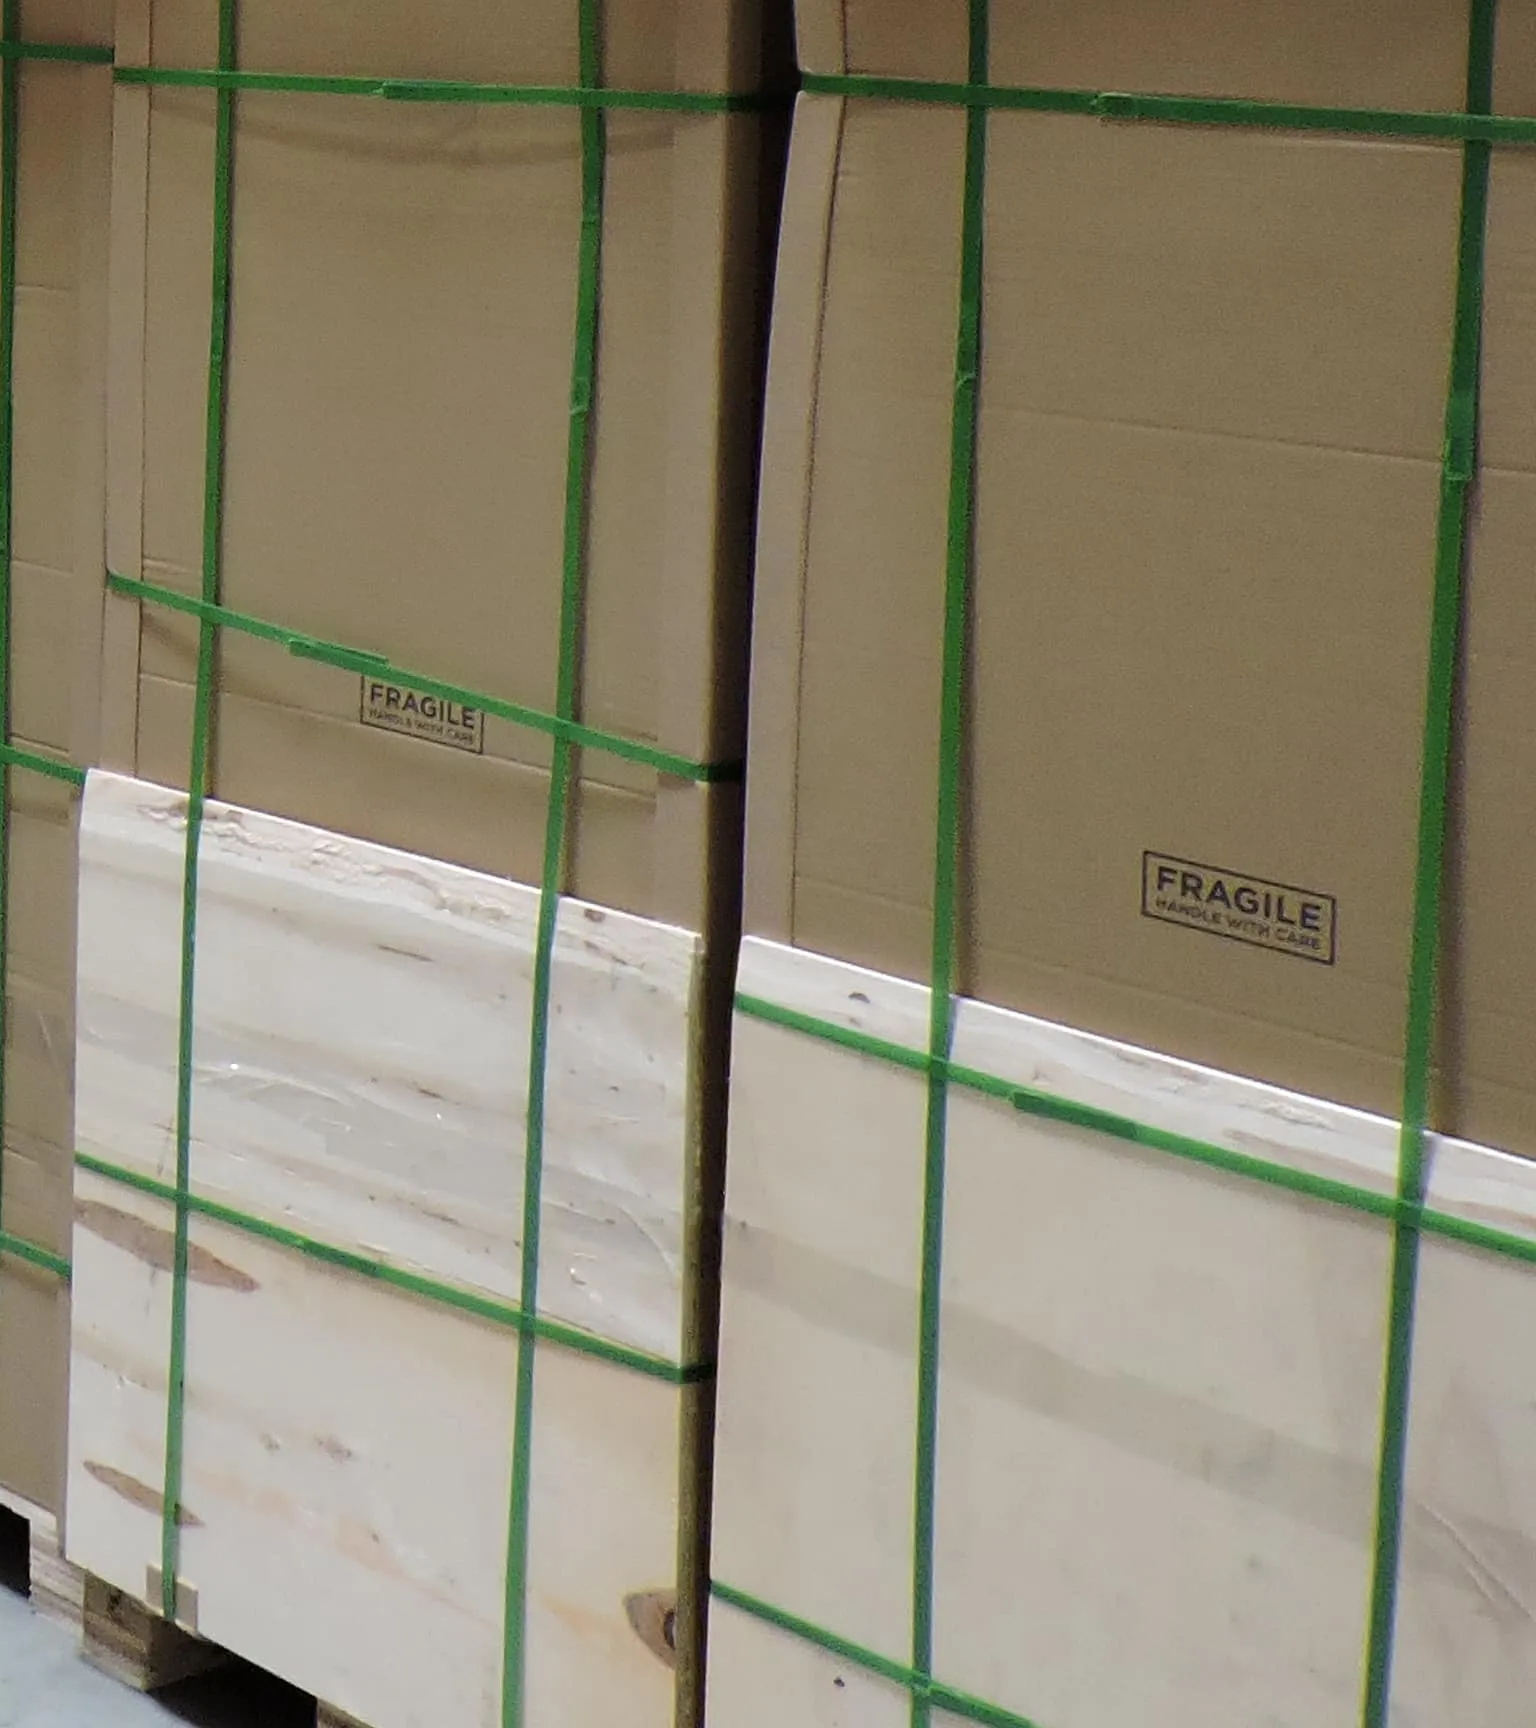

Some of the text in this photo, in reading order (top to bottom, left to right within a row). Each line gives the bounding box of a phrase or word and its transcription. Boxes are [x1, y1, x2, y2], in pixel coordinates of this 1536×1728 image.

[370, 683, 475, 730] FRAGILE
[1155, 897, 1322, 950] HANDLE WITH CARE
[1157, 866, 1321, 931] FRAGILE
